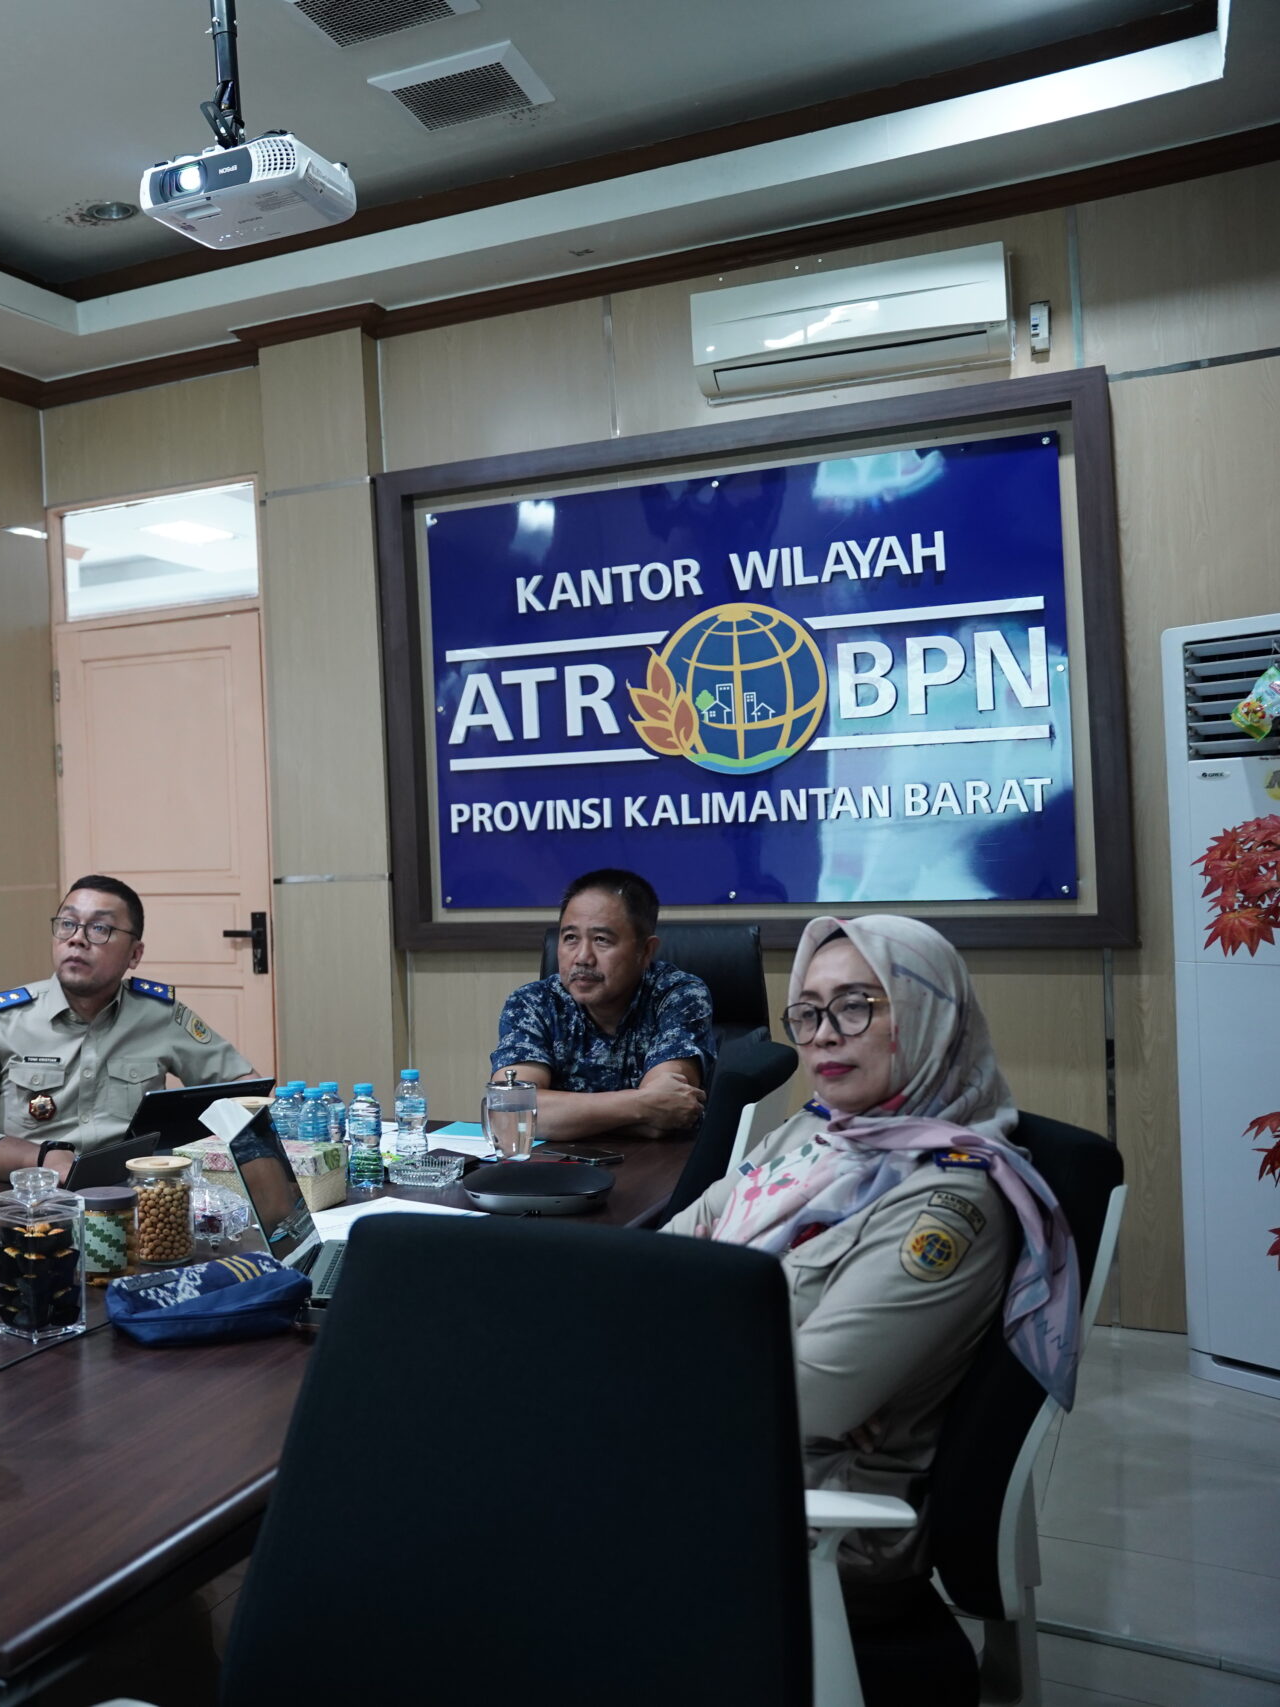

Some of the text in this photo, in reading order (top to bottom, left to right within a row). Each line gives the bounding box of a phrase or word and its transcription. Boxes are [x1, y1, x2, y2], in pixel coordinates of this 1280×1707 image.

[516, 530, 946, 614] KANTOR WILAYAH
[448, 626, 1050, 745] ATR BPN
[450, 777, 1053, 832] PROVINSI KALIMANTAN BARAT
